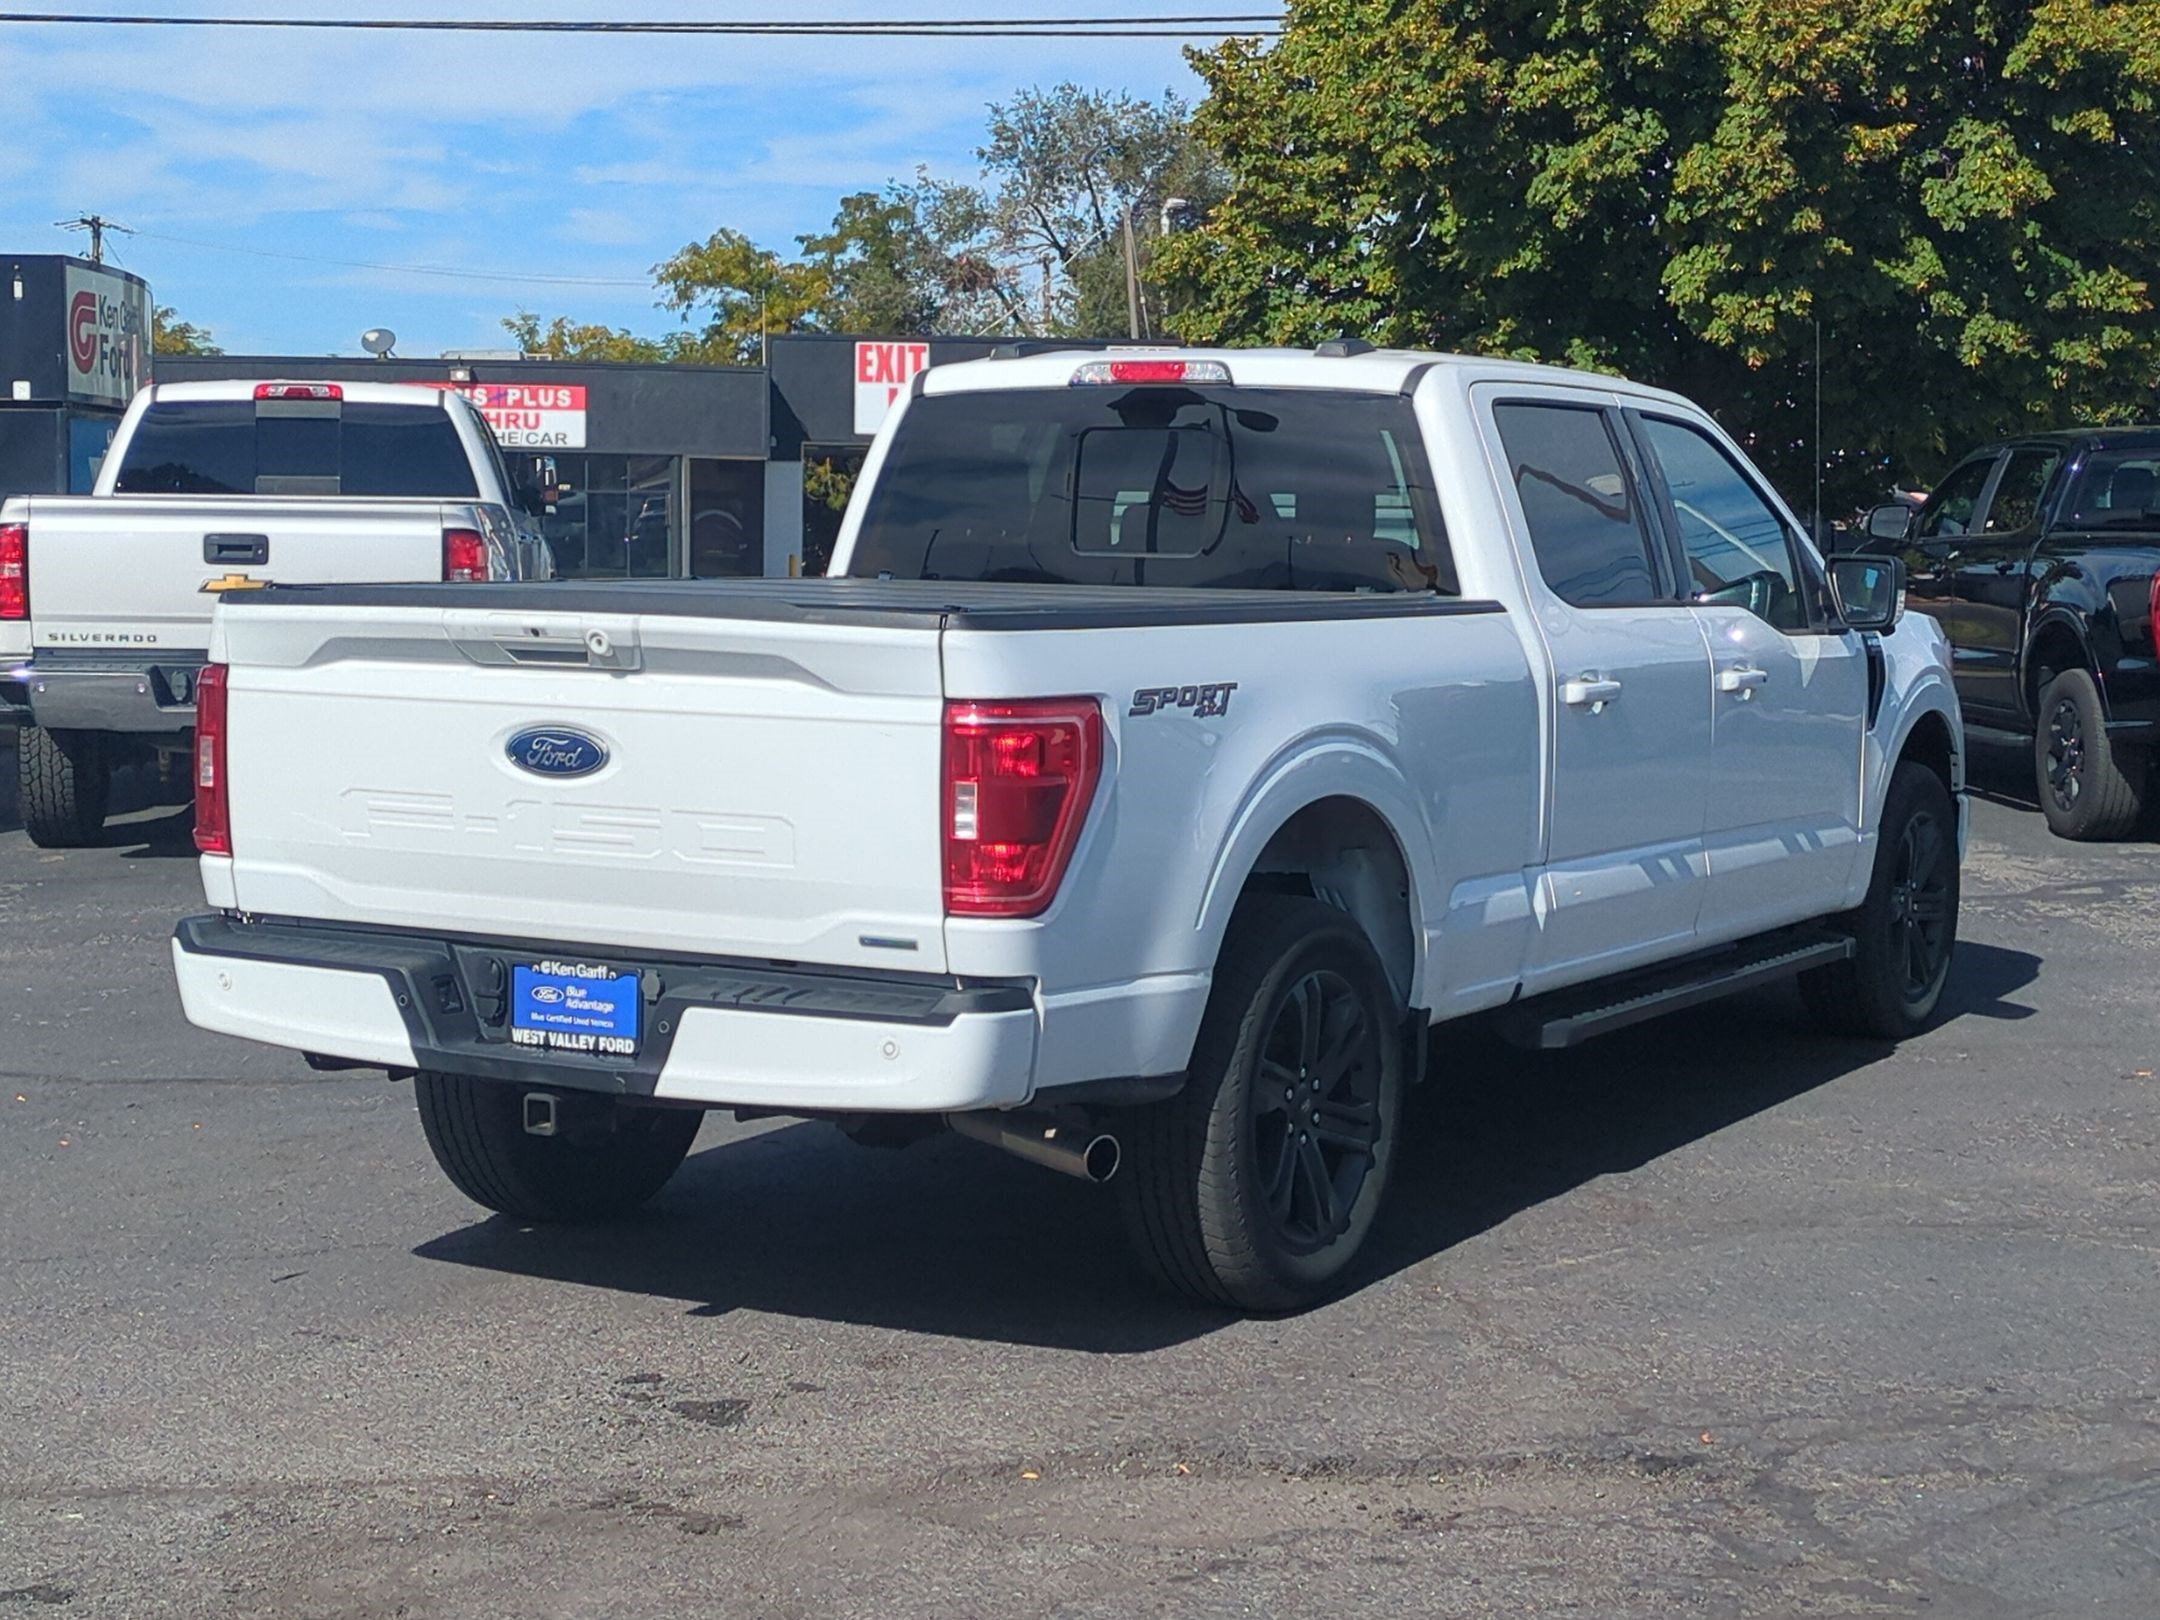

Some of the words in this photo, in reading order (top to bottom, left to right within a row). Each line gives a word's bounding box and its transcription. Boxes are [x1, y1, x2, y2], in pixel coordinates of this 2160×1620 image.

[98, 293, 118, 328] Ken
[100, 334, 131, 381] Ford
[858, 344, 927, 383] EXIT
[507, 387, 572, 408] PLUS
[484, 412, 540, 431] HRU
[496, 431, 517, 445] HE
[525, 432, 568, 445] CAR
[48, 632, 157, 643] SILVERADO
[1128, 682, 1238, 718] SPORT
[526, 736, 582, 768] Ford
[339, 787, 795, 869] F-150
[551, 961, 575, 978] Ken
[576, 963, 608, 980] Garff
[565, 998, 614, 1014] Advantage
[511, 1028, 546, 1046] WEST
[548, 1031, 597, 1051] VALLEY
[598, 1037, 635, 1053] FORD
